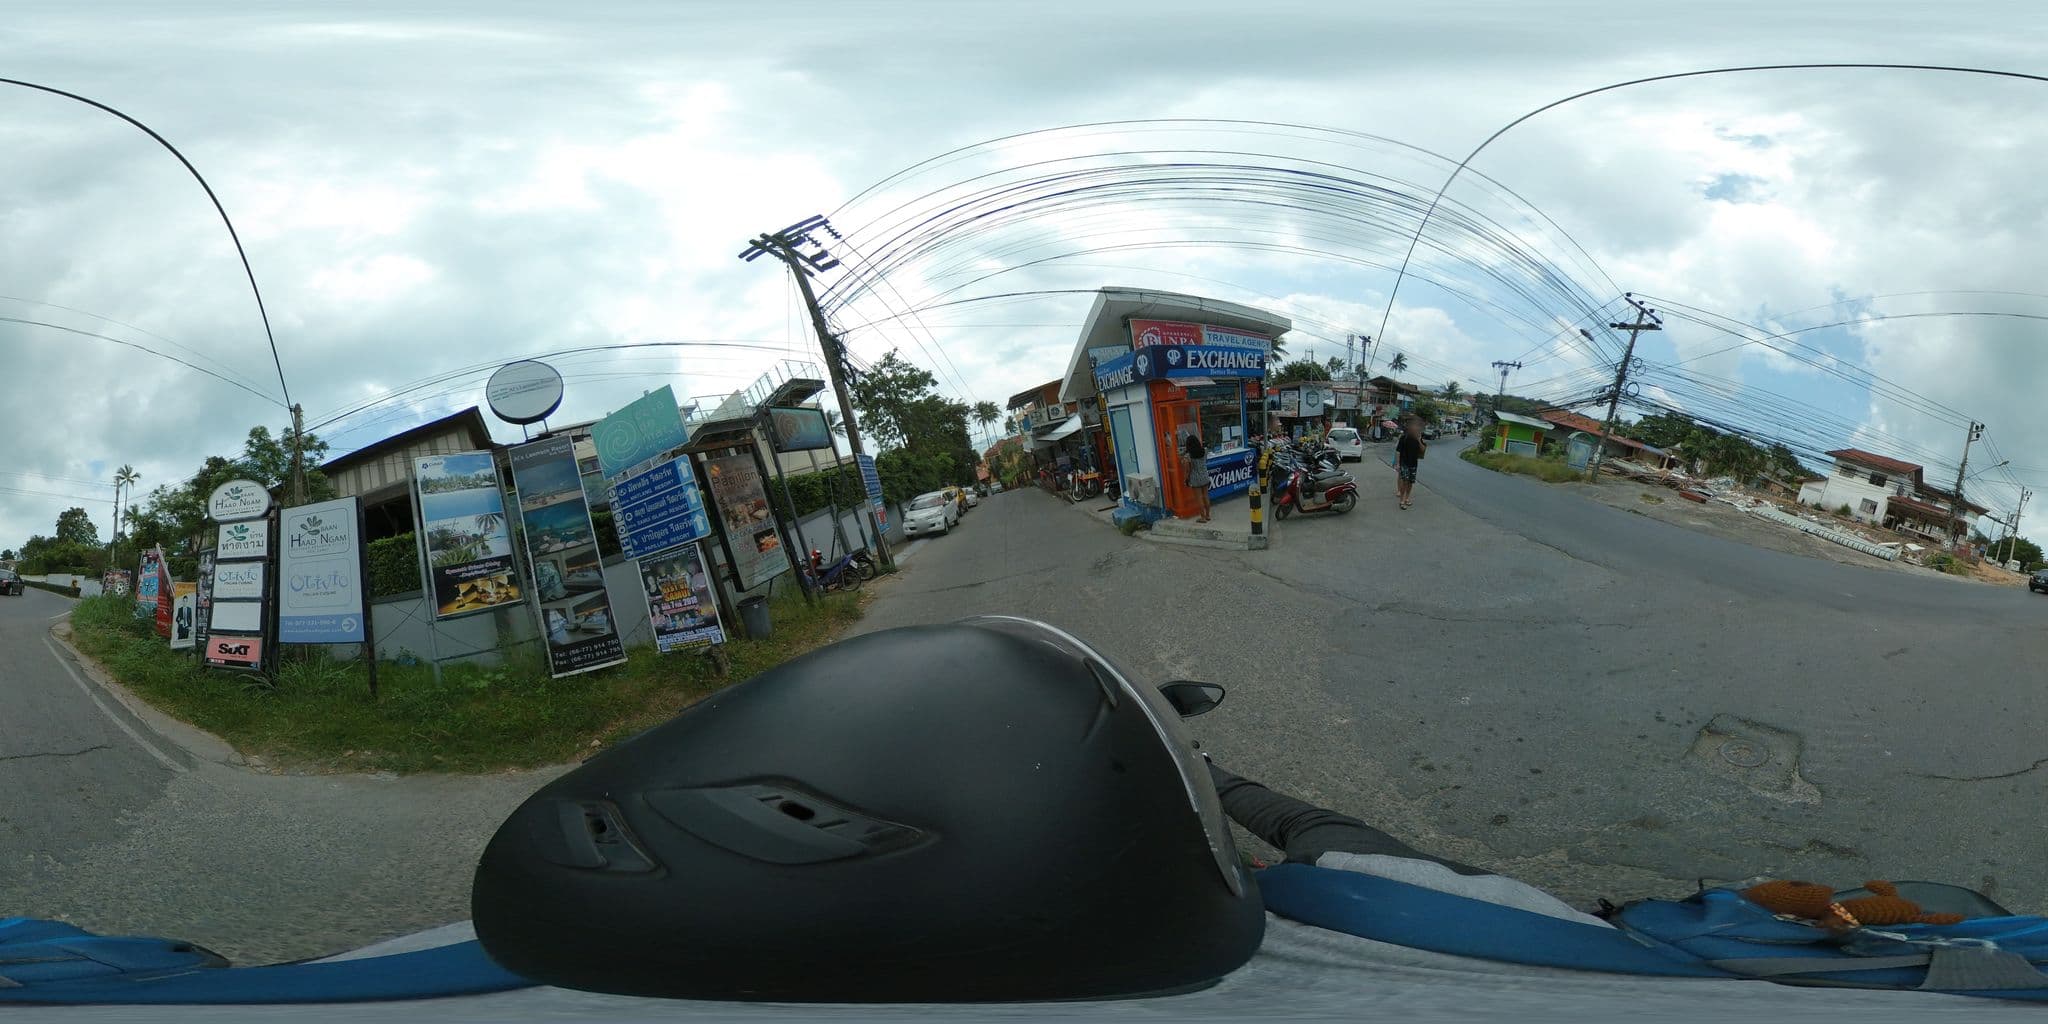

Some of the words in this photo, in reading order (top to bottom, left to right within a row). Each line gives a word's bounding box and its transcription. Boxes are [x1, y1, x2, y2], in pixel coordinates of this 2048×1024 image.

[1206, 332, 1237, 345] TRAVEL
[1241, 337, 1270, 350] AGENCY
[1187, 350, 1262, 369] EXCHANGE
[1098, 364, 1135, 391] EXCHANGE
[1208, 465, 1253, 491] XCHANGE
[669, 502, 688, 513] RESORT
[290, 533, 317, 548] HAAD
[321, 533, 347, 545] NGAM
